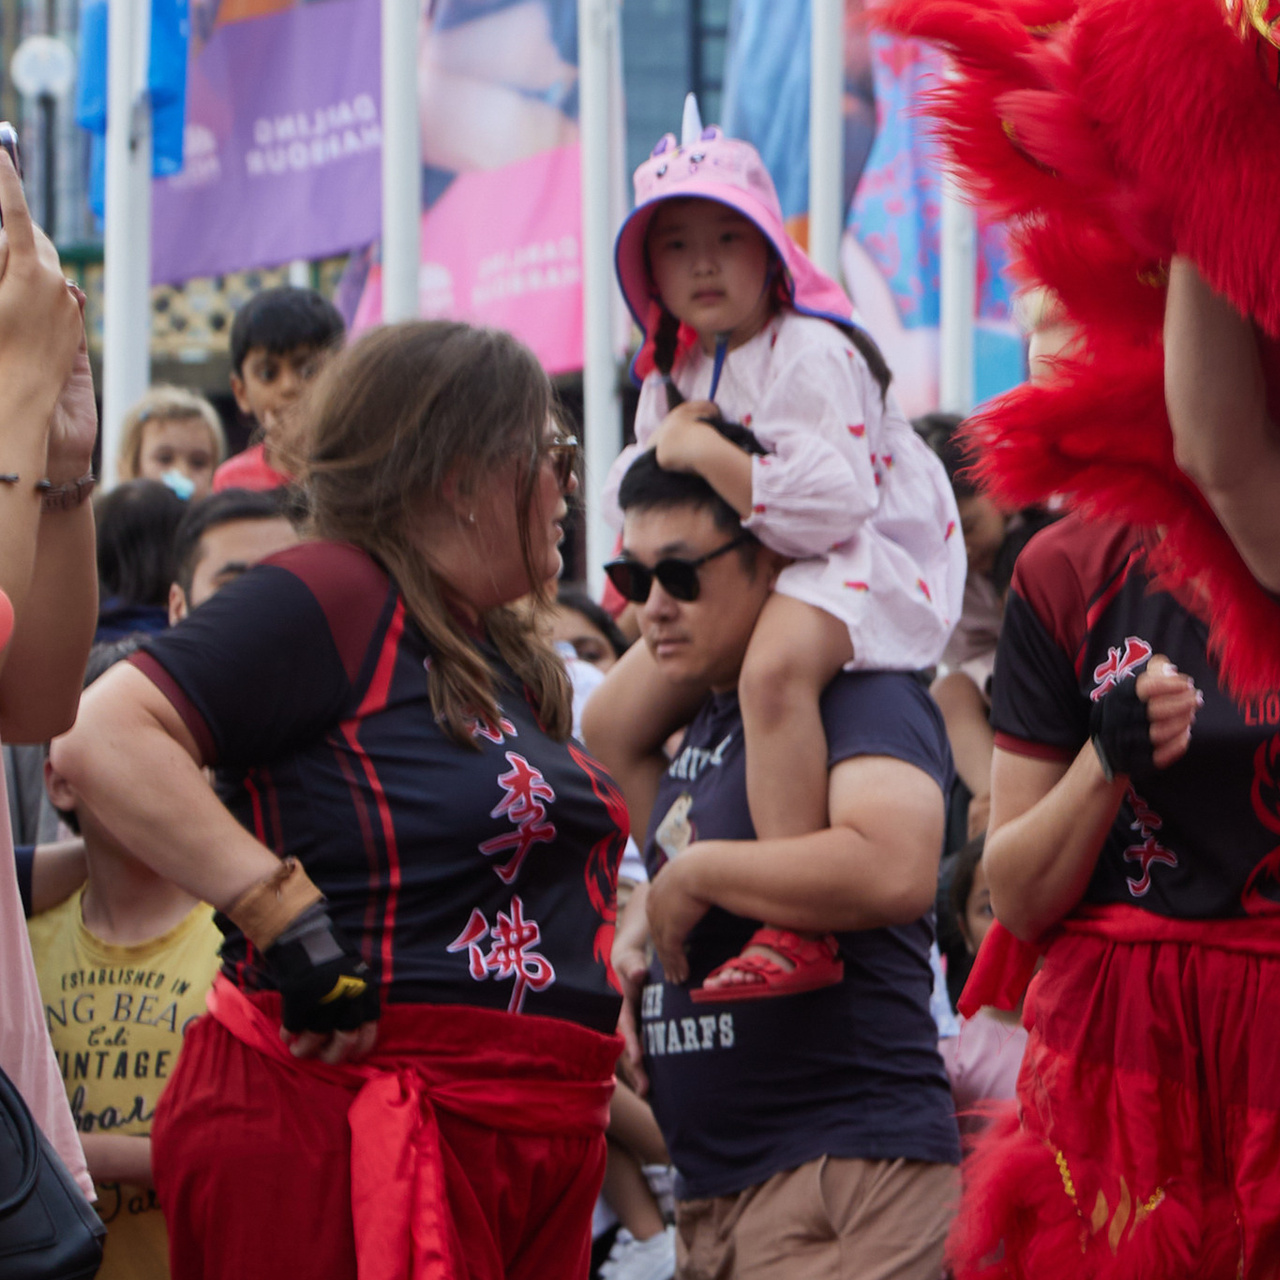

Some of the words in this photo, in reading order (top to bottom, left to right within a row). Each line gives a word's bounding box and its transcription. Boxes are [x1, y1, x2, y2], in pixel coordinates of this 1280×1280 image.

[62, 969, 164, 991] ESTABLISHED
[171, 977, 190, 996] IN
[46, 992, 95, 1033] NG
[644, 1012, 735, 1056] WARFS
